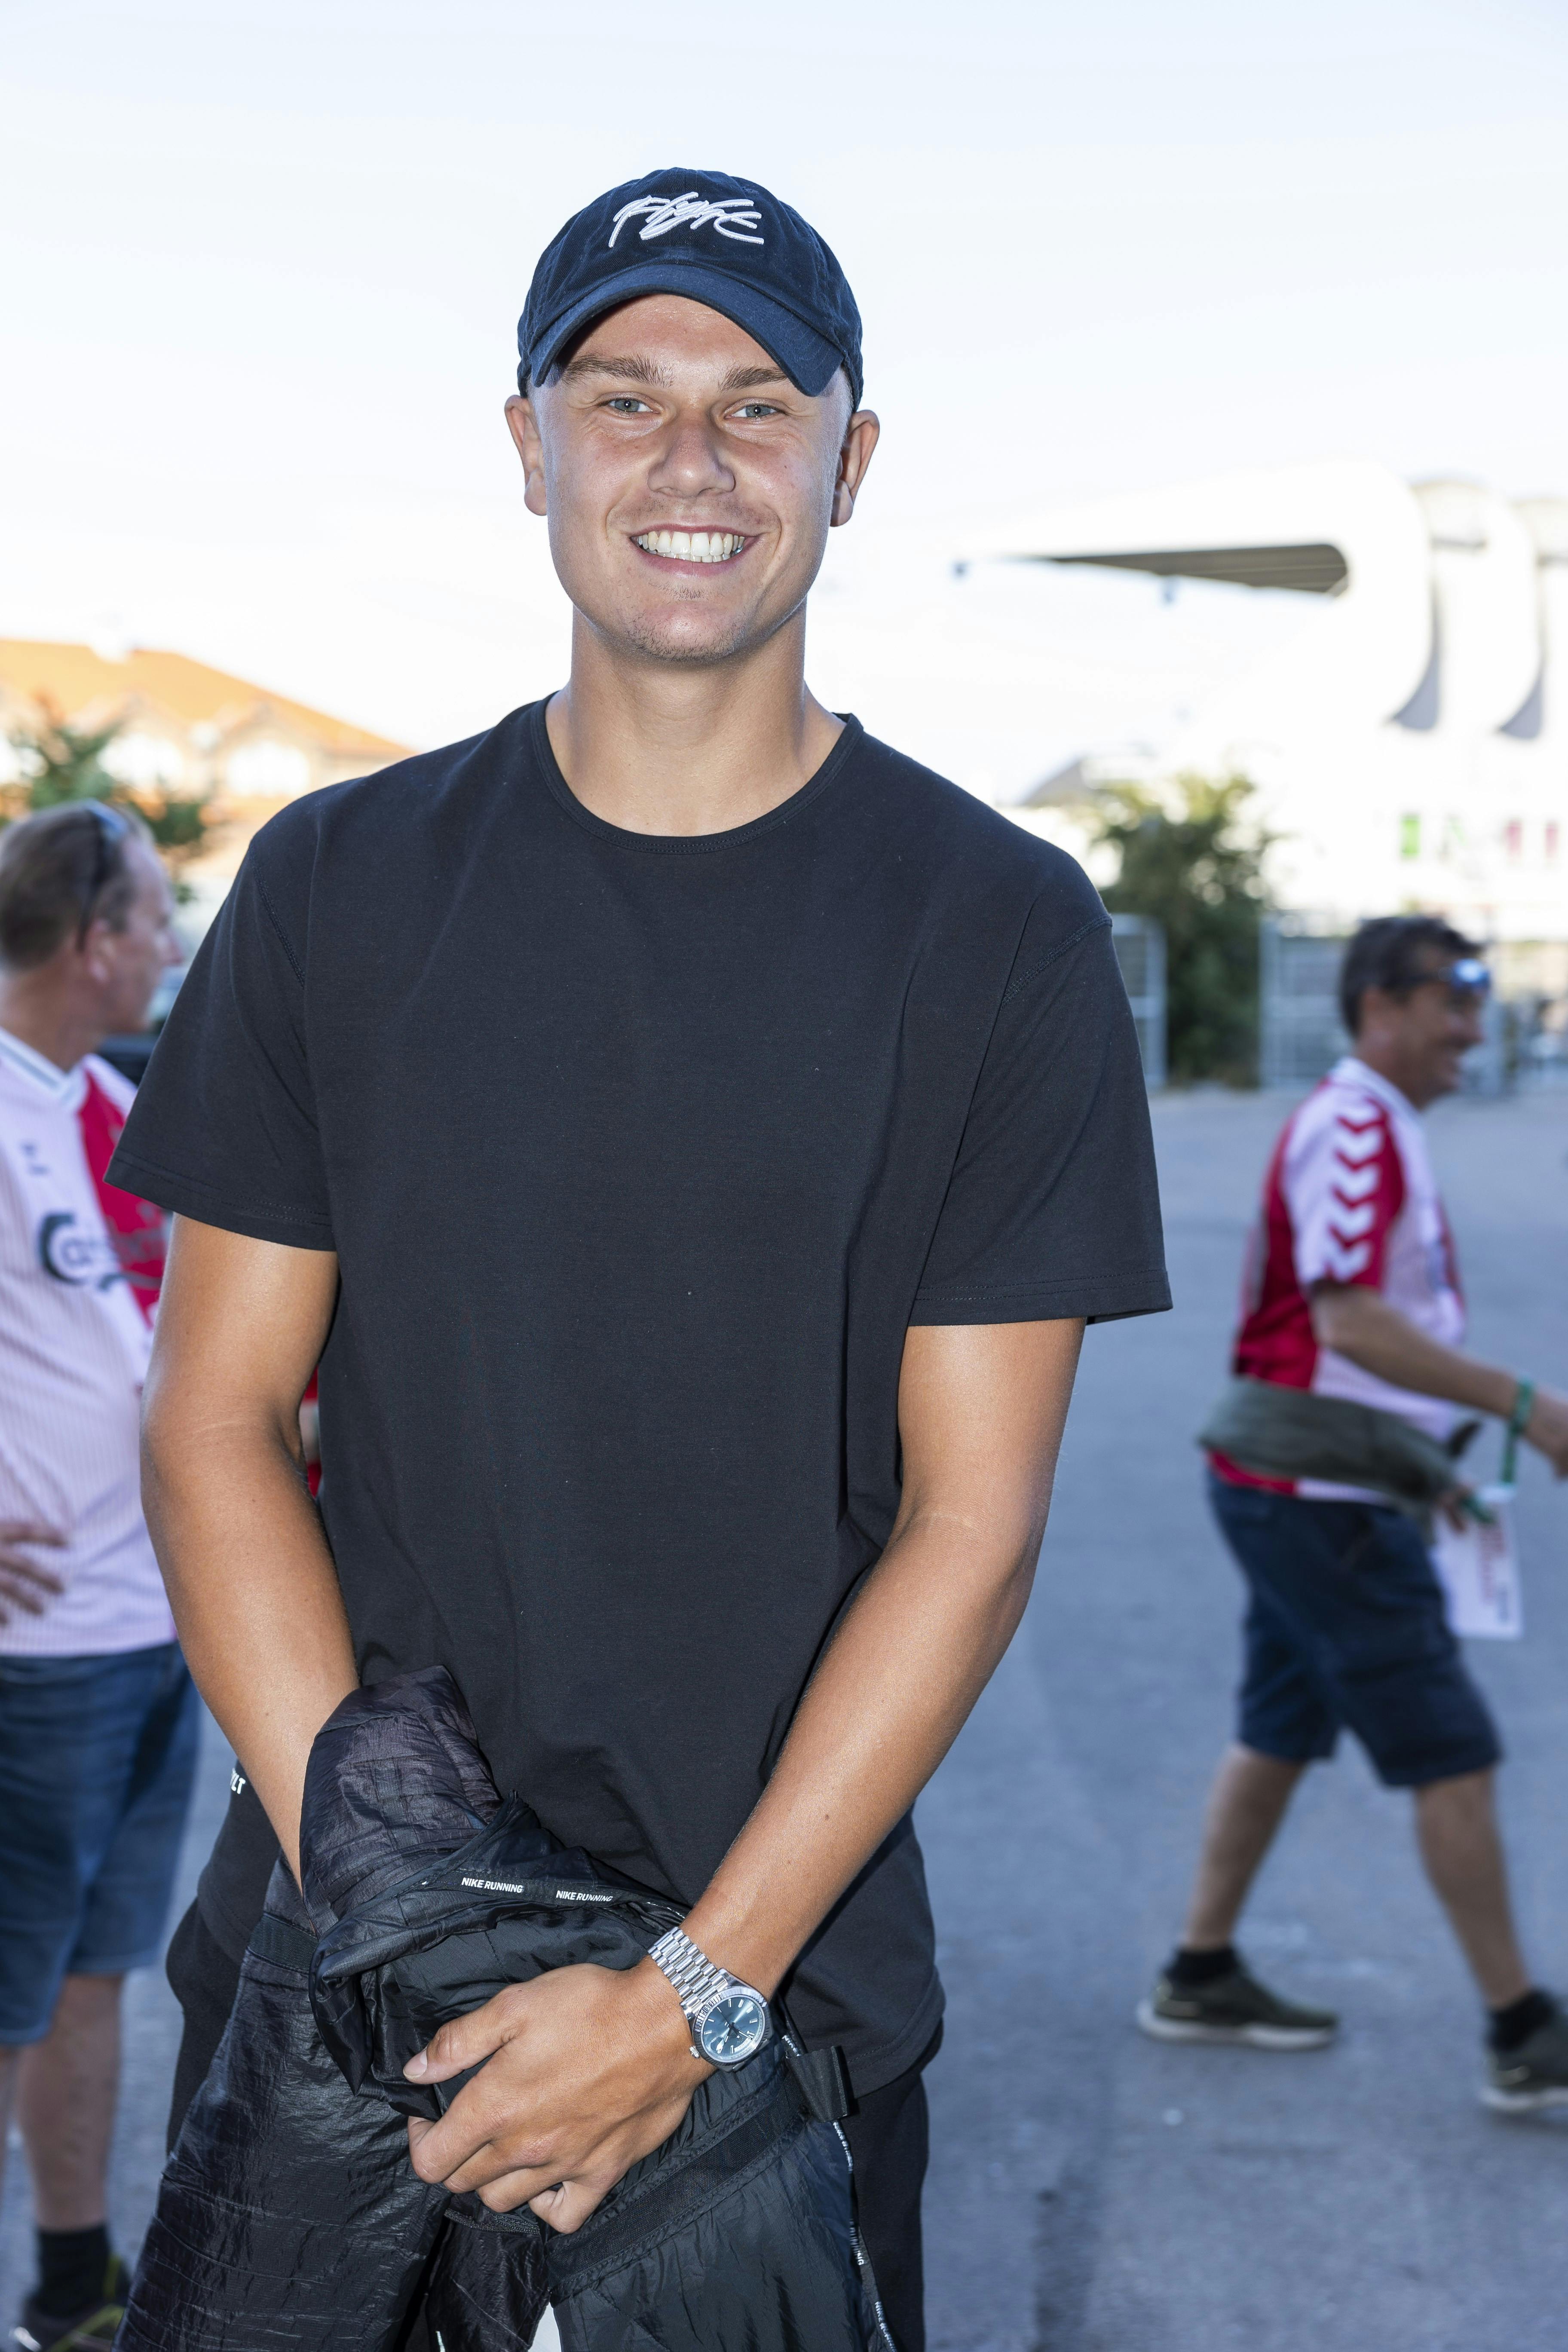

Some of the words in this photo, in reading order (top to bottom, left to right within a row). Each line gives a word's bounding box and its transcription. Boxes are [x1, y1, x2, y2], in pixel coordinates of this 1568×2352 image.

[461, 1877, 484, 1888] NIKE
[484, 1881, 523, 1893] RUNNING
[556, 1890, 576, 1900] NIKE
[576, 1893, 613, 1902] RUNNING
